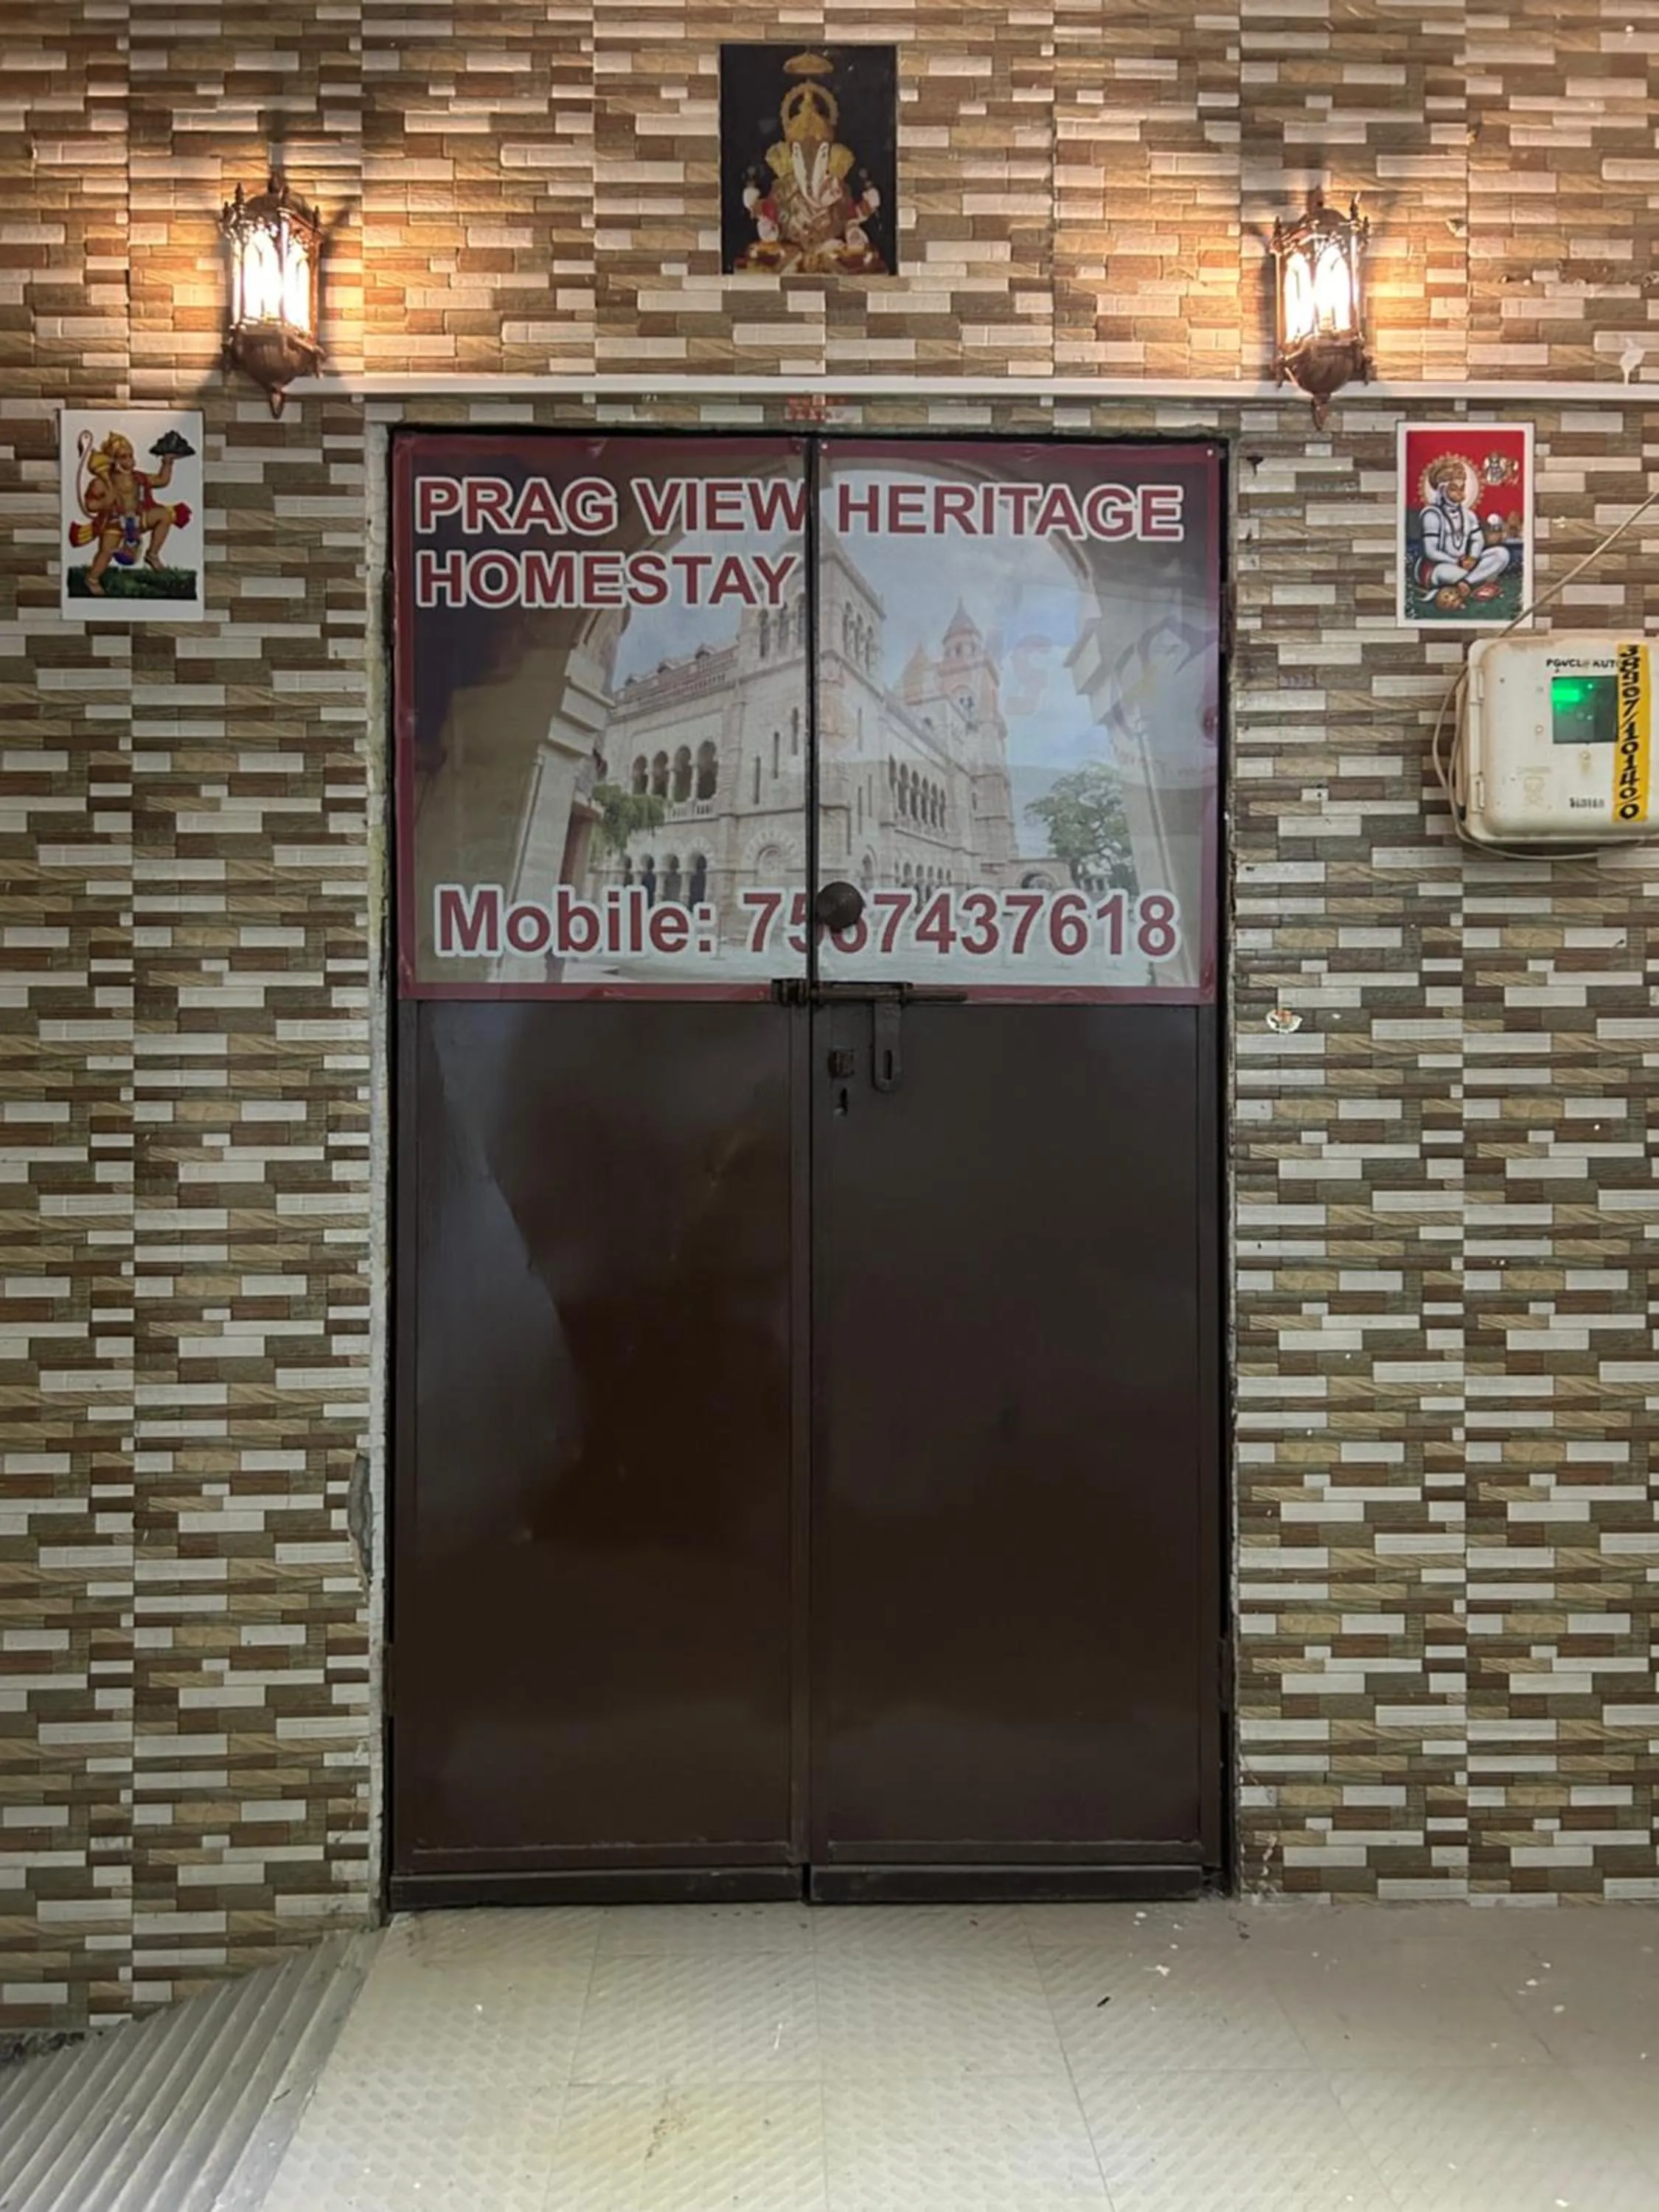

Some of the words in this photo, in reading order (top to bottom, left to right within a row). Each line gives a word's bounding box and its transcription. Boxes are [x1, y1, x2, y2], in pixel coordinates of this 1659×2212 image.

[415, 477, 619, 535] PRAG
[631, 478, 806, 535] VIEW
[835, 481, 1184, 543] HERITAGE
[416, 550, 801, 609] HOMESTAY
[435, 885, 717, 961] Mobile:
